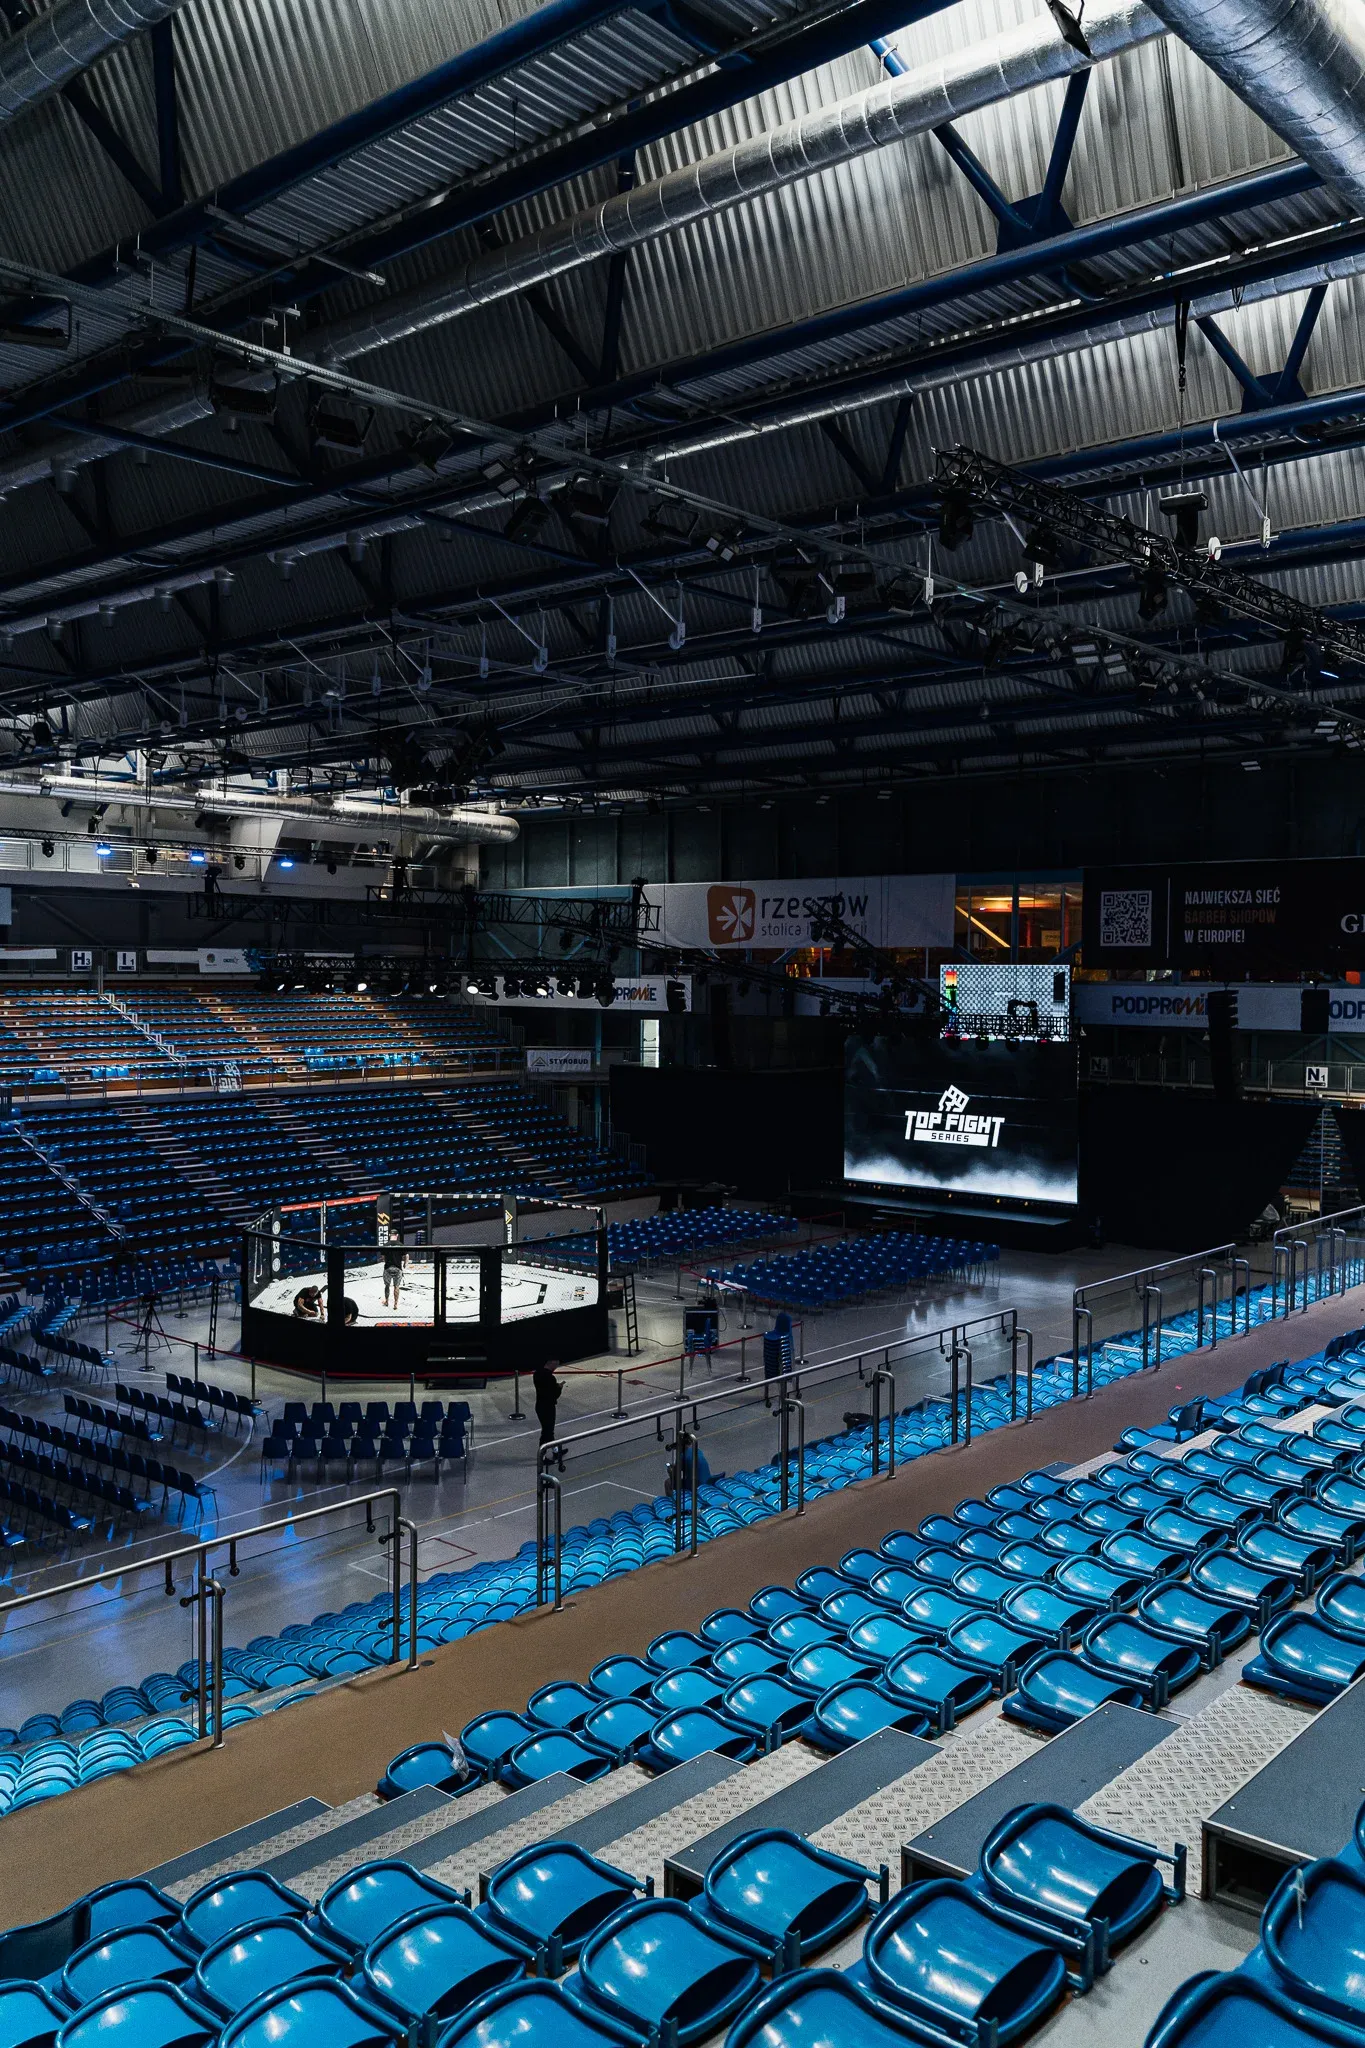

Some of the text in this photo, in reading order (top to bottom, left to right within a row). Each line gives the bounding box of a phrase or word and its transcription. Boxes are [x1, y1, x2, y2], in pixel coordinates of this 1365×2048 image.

[1185, 887, 1280, 906] NAJWIĘKSZA SIEĆ
[1185, 910, 1226, 924] BARBER
[761, 923, 802, 936] stolica
[1184, 929, 1245, 943] W EUROPIE!
[1329, 1000, 1365, 1019] ODP
[904, 1110, 1005, 1148] TOP FIGHT
[931, 1132, 970, 1143] SERIES
